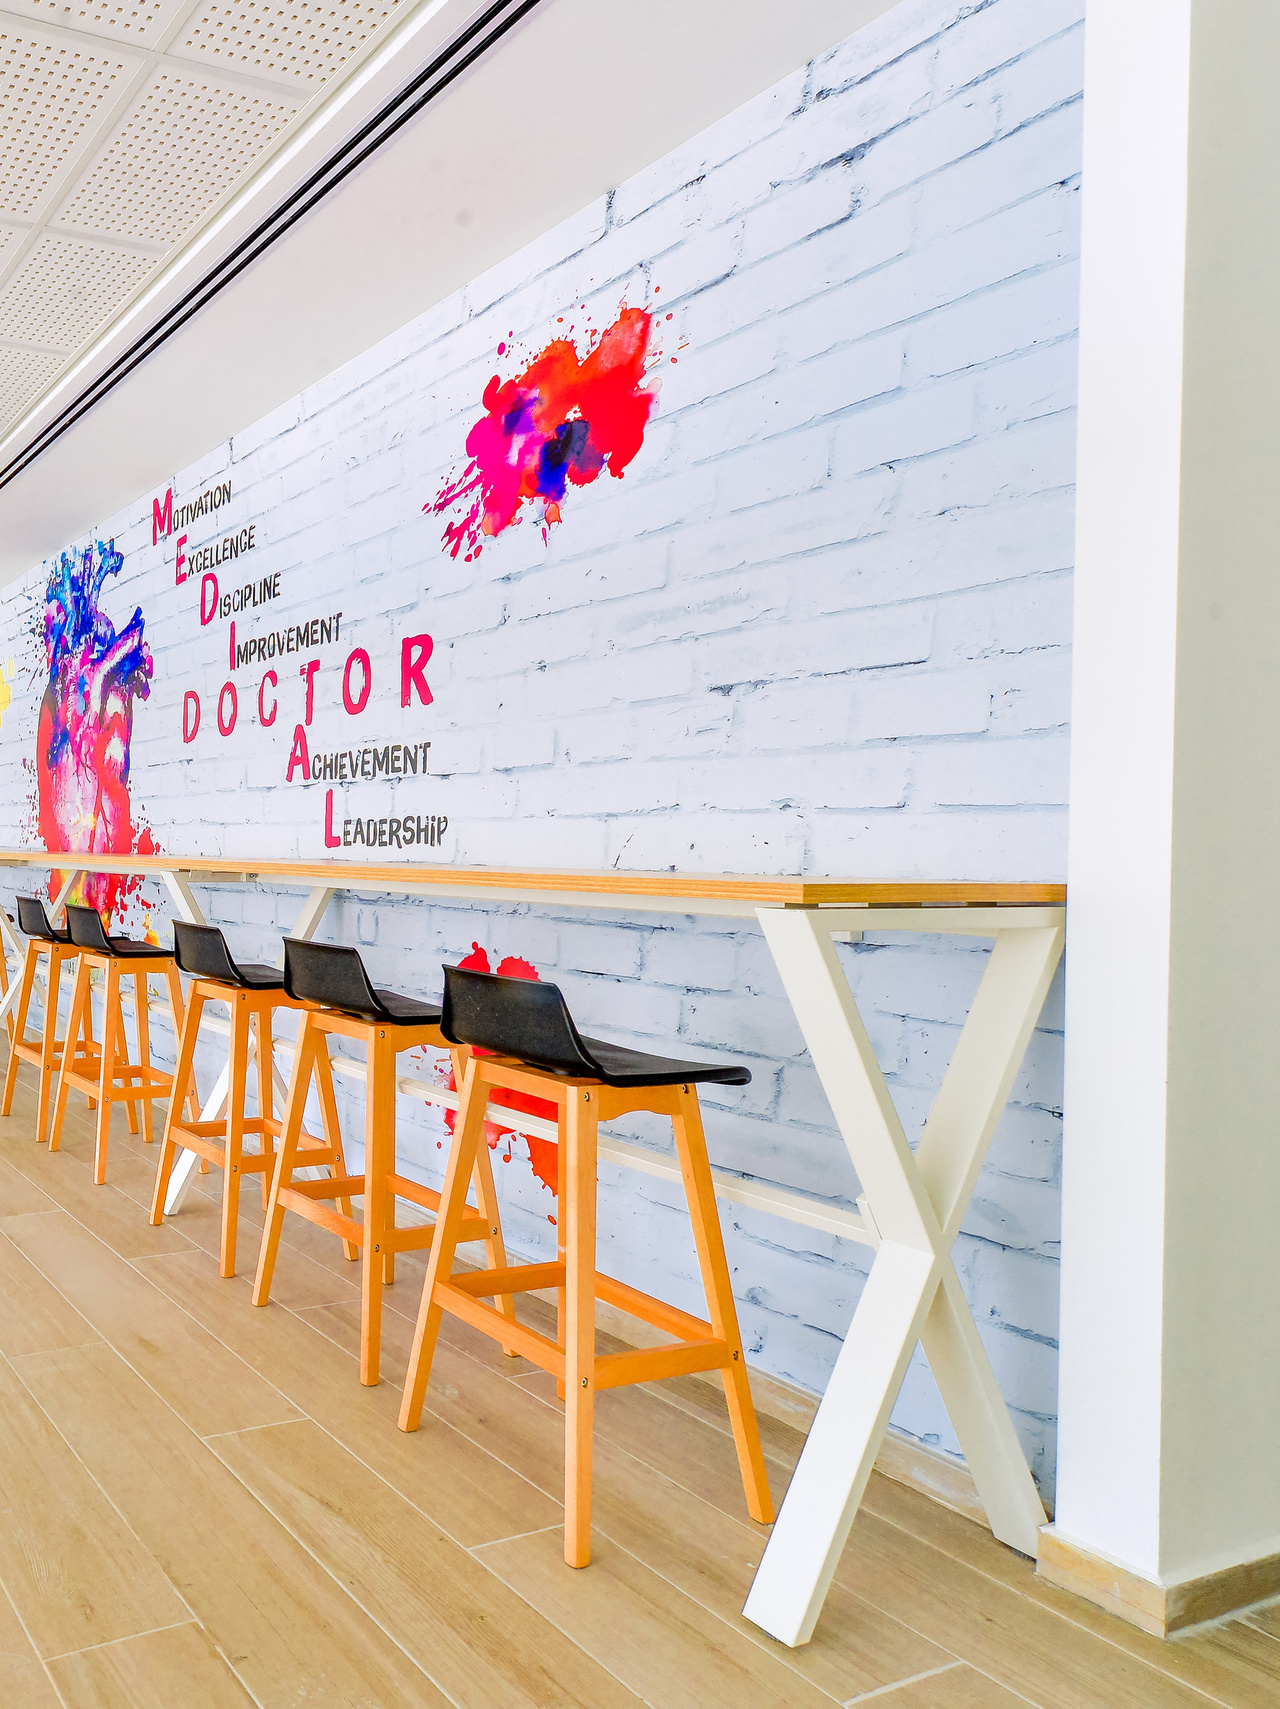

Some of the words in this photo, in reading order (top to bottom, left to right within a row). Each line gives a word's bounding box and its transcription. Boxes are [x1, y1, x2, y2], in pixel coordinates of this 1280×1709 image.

[152, 480, 232, 546] MOTIVATION
[175, 524, 256, 585] EXCELLENCE
[200, 572, 281, 626] DISCIPLINE
[229, 612, 342, 671] IMPROVEMENT
[183, 634, 434, 743] DOCTOR
[285, 724, 431, 782] ACHIEVEMENT
